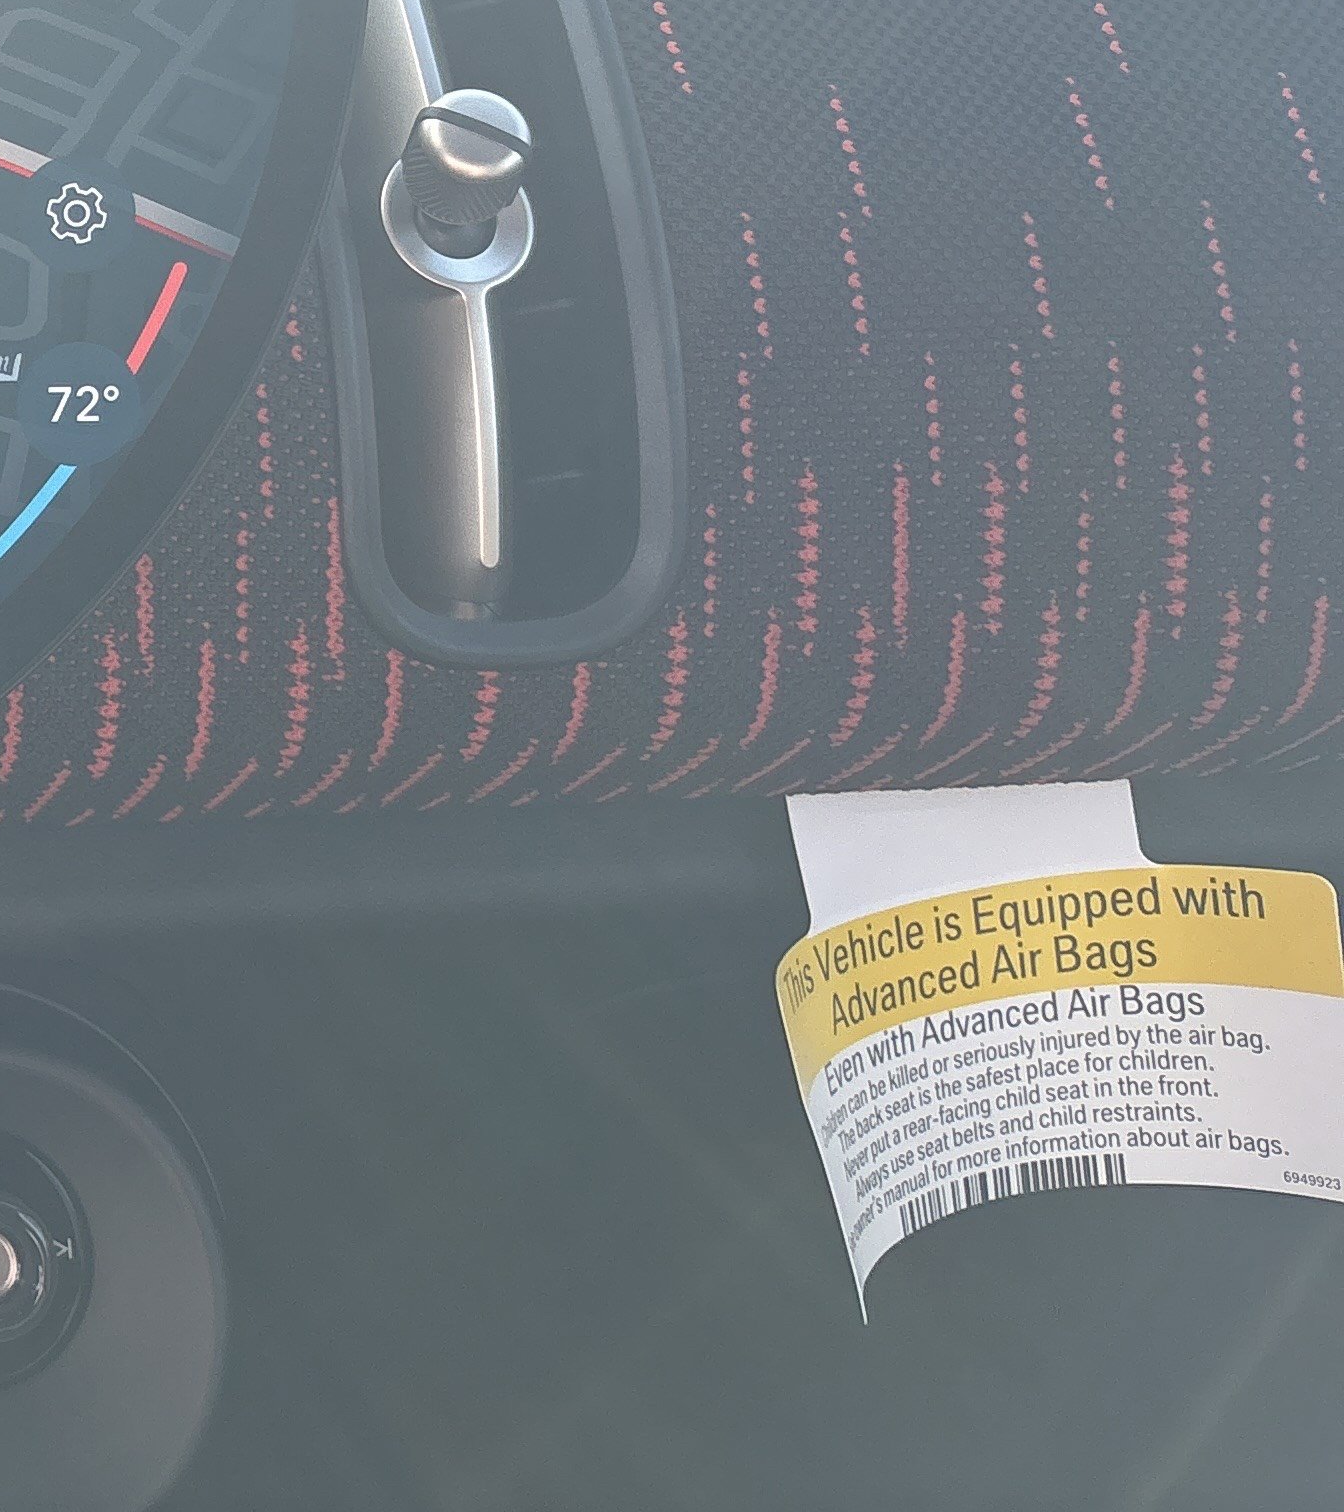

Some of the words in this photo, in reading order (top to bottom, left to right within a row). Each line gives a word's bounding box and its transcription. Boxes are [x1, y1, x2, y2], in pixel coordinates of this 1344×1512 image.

[46, 384, 121, 423] 72°
[783, 958, 814, 1014] This
[813, 915, 924, 981] Vehicle
[933, 905, 962, 944] is
[972, 876, 1161, 937] Equipped
[1173, 877, 1265, 919] with
[832, 949, 980, 1035] Advanced
[992, 941, 1041, 983] Air
[1054, 934, 1157, 977] Bags
[824, 1051, 864, 1097] Even
[866, 1025, 915, 1066] with
[922, 991, 1059, 1048] Advanced
[1067, 986, 1111, 1020] Air
[1120, 985, 1205, 1022] Bags
[848, 1089, 868, 1114] can
[868, 1078, 886, 1100] be
[887, 1057, 929, 1091] killed
[932, 1056, 949, 1075] or
[953, 1035, 1035, 1069] seriously
[1040, 1025, 1110, 1055] injured
[1115, 1024, 1141, 1049] by
[1147, 1024, 1182, 1045] the
[1188, 1024, 1216, 1045] air
[1221, 1025, 1270, 1054] bag.
[838, 1127, 856, 1154] The
[855, 1105, 884, 1138] back
[884, 1091, 916, 1121] seat
[918, 1086, 931, 1106] is
[935, 1079, 962, 1101] the
[966, 1063, 1021, 1092] safest
[1026, 1058, 1079, 1084] place
[1084, 1052, 1113, 1072] for
[1119, 1050, 1215, 1071] children.
[844, 1147, 869, 1182] Never
[870, 1131, 891, 1163] put
[893, 1129, 901, 1145] a
[903, 1097, 991, 1140] rear-facing
[996, 1084, 1041, 1110] child
[1046, 1080, 1090, 1101] seat
[1094, 1077, 1113, 1097] in
[1118, 1076, 1153, 1096] the
[1158, 1075, 1219, 1097] front.
[855, 1163, 889, 1203] Always
[890, 1149, 915, 1174] use
[917, 1132, 950, 1161] seat
[952, 1121, 995, 1147] belts
[999, 1110, 1034, 1135] and
[1039, 1104, 1087, 1128] child
[1092, 1100, 1203, 1123] restraints.
[884, 1164, 930, 1207] manual
[932, 1160, 953, 1182] for
[957, 1147, 1001, 1172] more
[1005, 1128, 1121, 1159] information
[1127, 1127, 1190, 1148] about
[1195, 1128, 1223, 1149] air
[1228, 1129, 1290, 1158] bags.
[1283, 1171, 1341, 1190] 6949923
